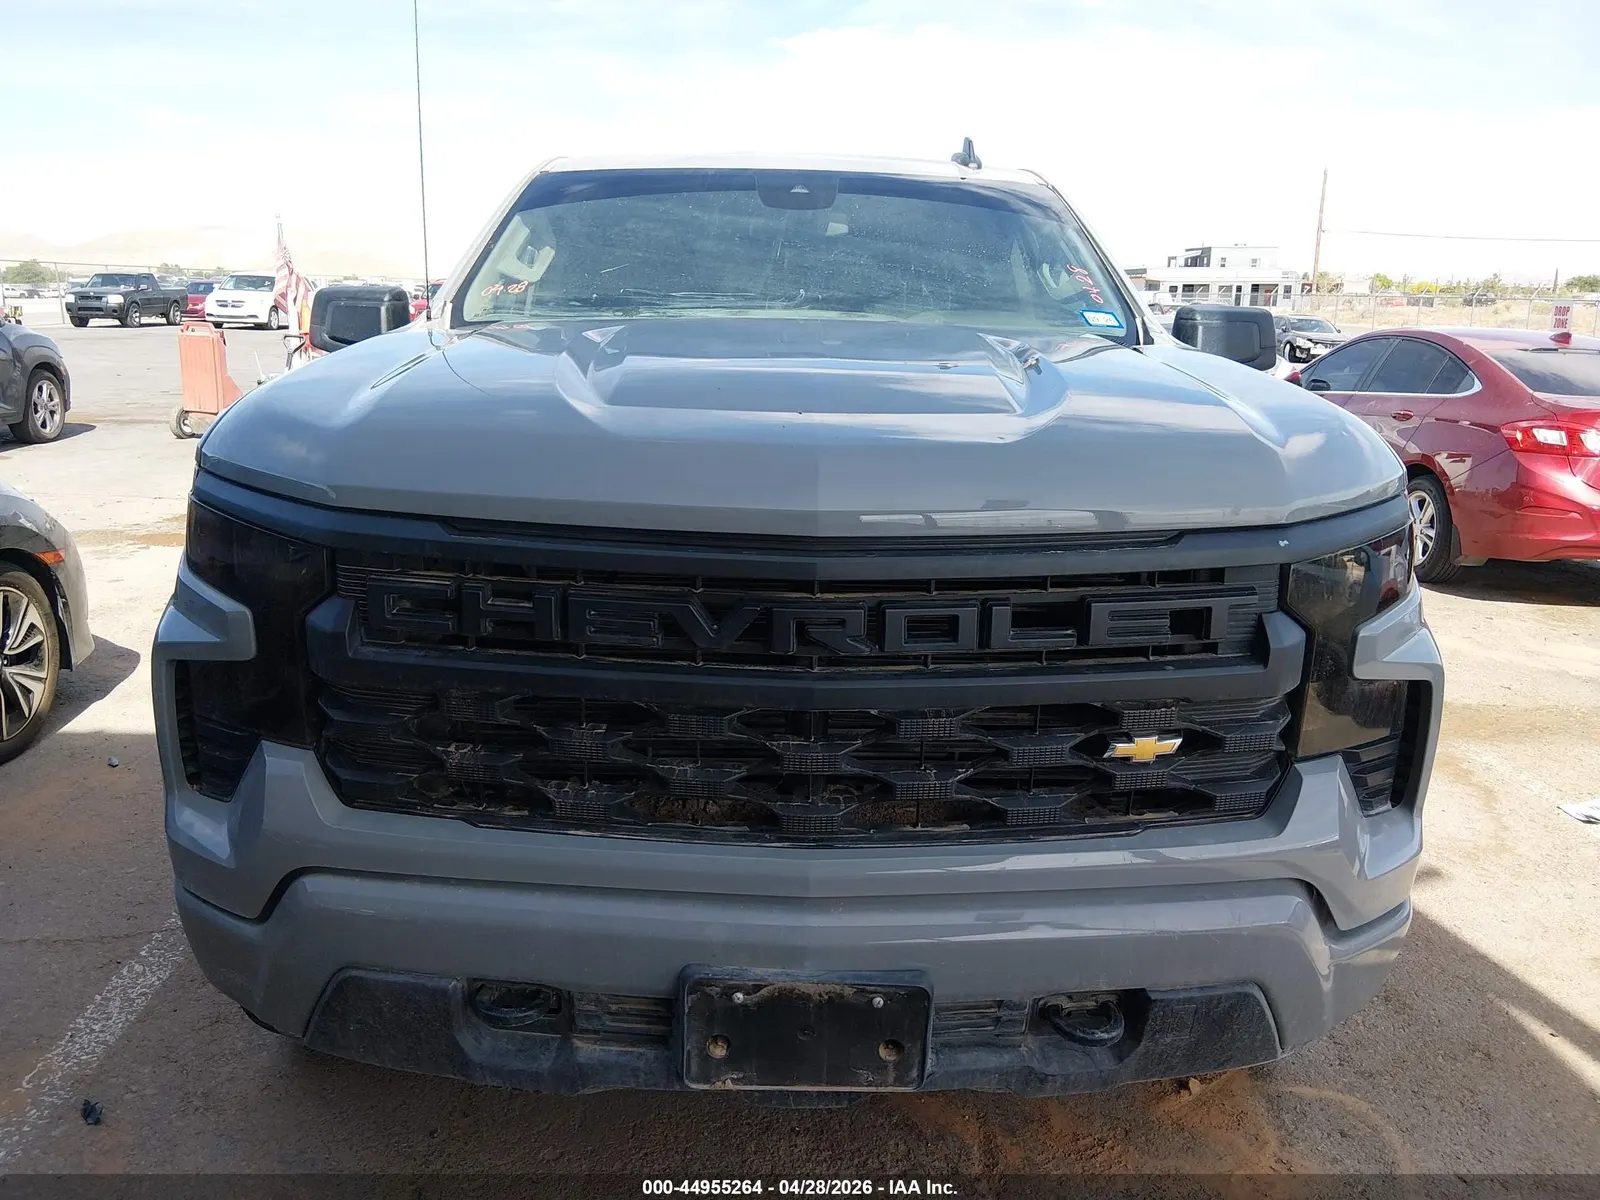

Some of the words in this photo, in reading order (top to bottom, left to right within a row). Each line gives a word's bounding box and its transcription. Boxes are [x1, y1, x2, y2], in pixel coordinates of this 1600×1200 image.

[1554, 305, 1571, 317] DROP
[1553, 317, 1569, 329] ZONE
[366, 574, 1259, 655] CHEVROLET
